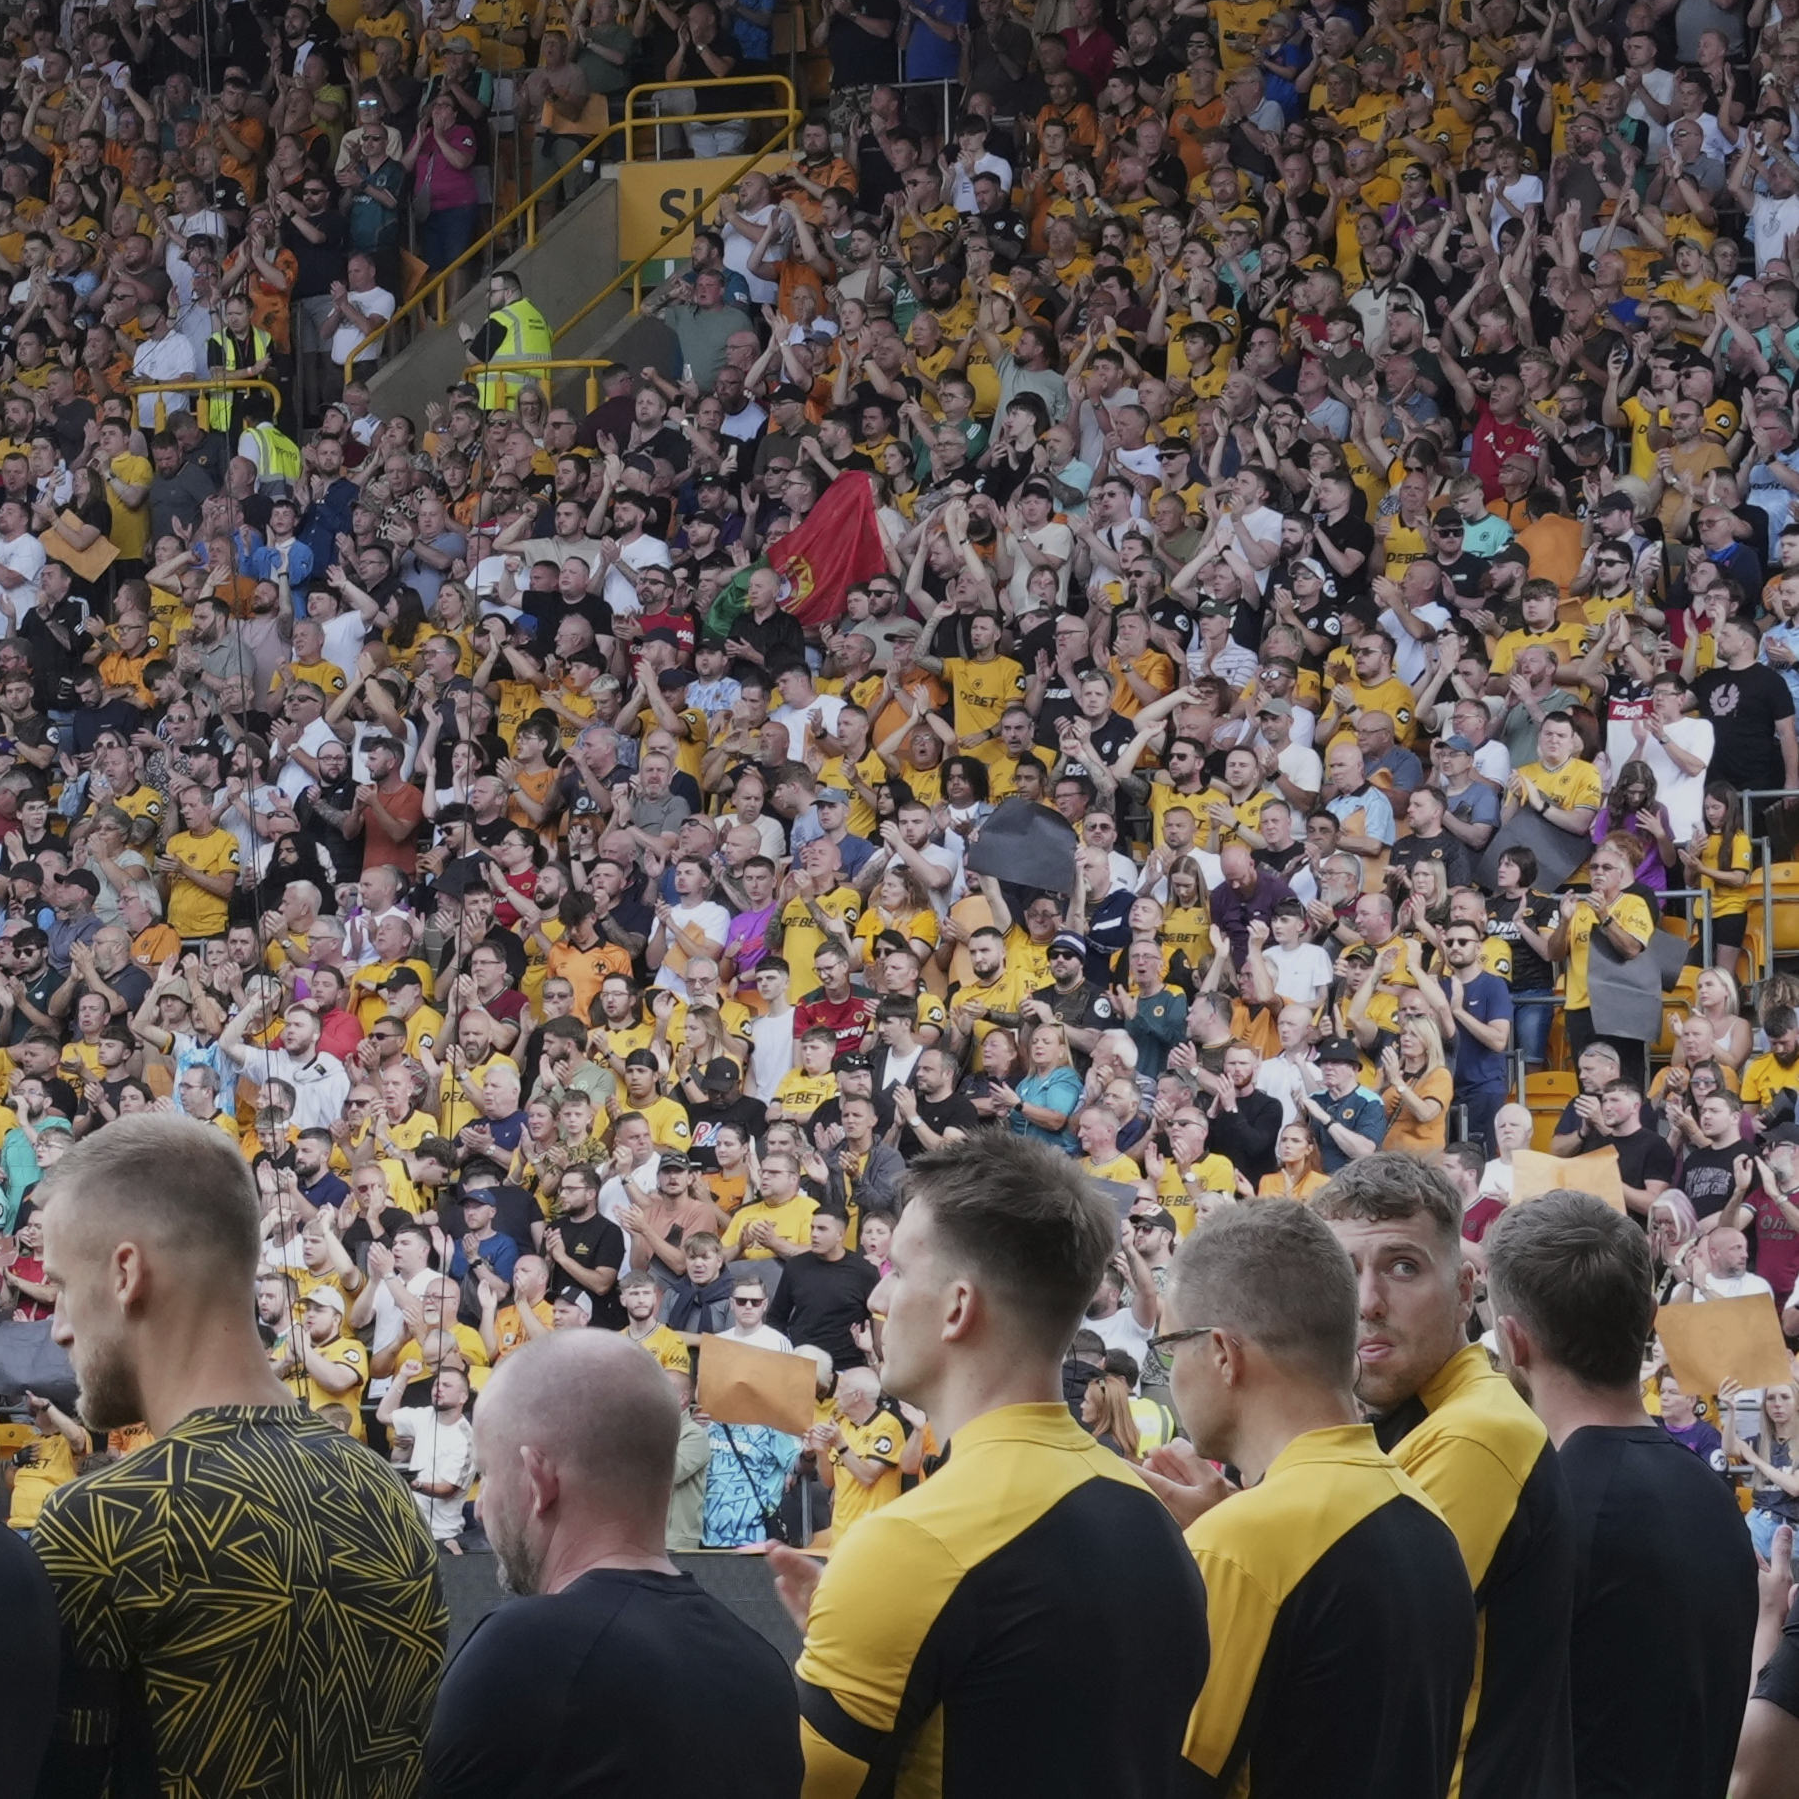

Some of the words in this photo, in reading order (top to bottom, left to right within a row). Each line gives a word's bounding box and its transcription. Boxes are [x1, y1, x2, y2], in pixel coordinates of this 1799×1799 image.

[960, 689, 999, 709] DEBET
[783, 915, 816, 927] DEBE
[782, 1092, 822, 1104] DEBET
[1158, 1195, 1192, 1206] DEBE
